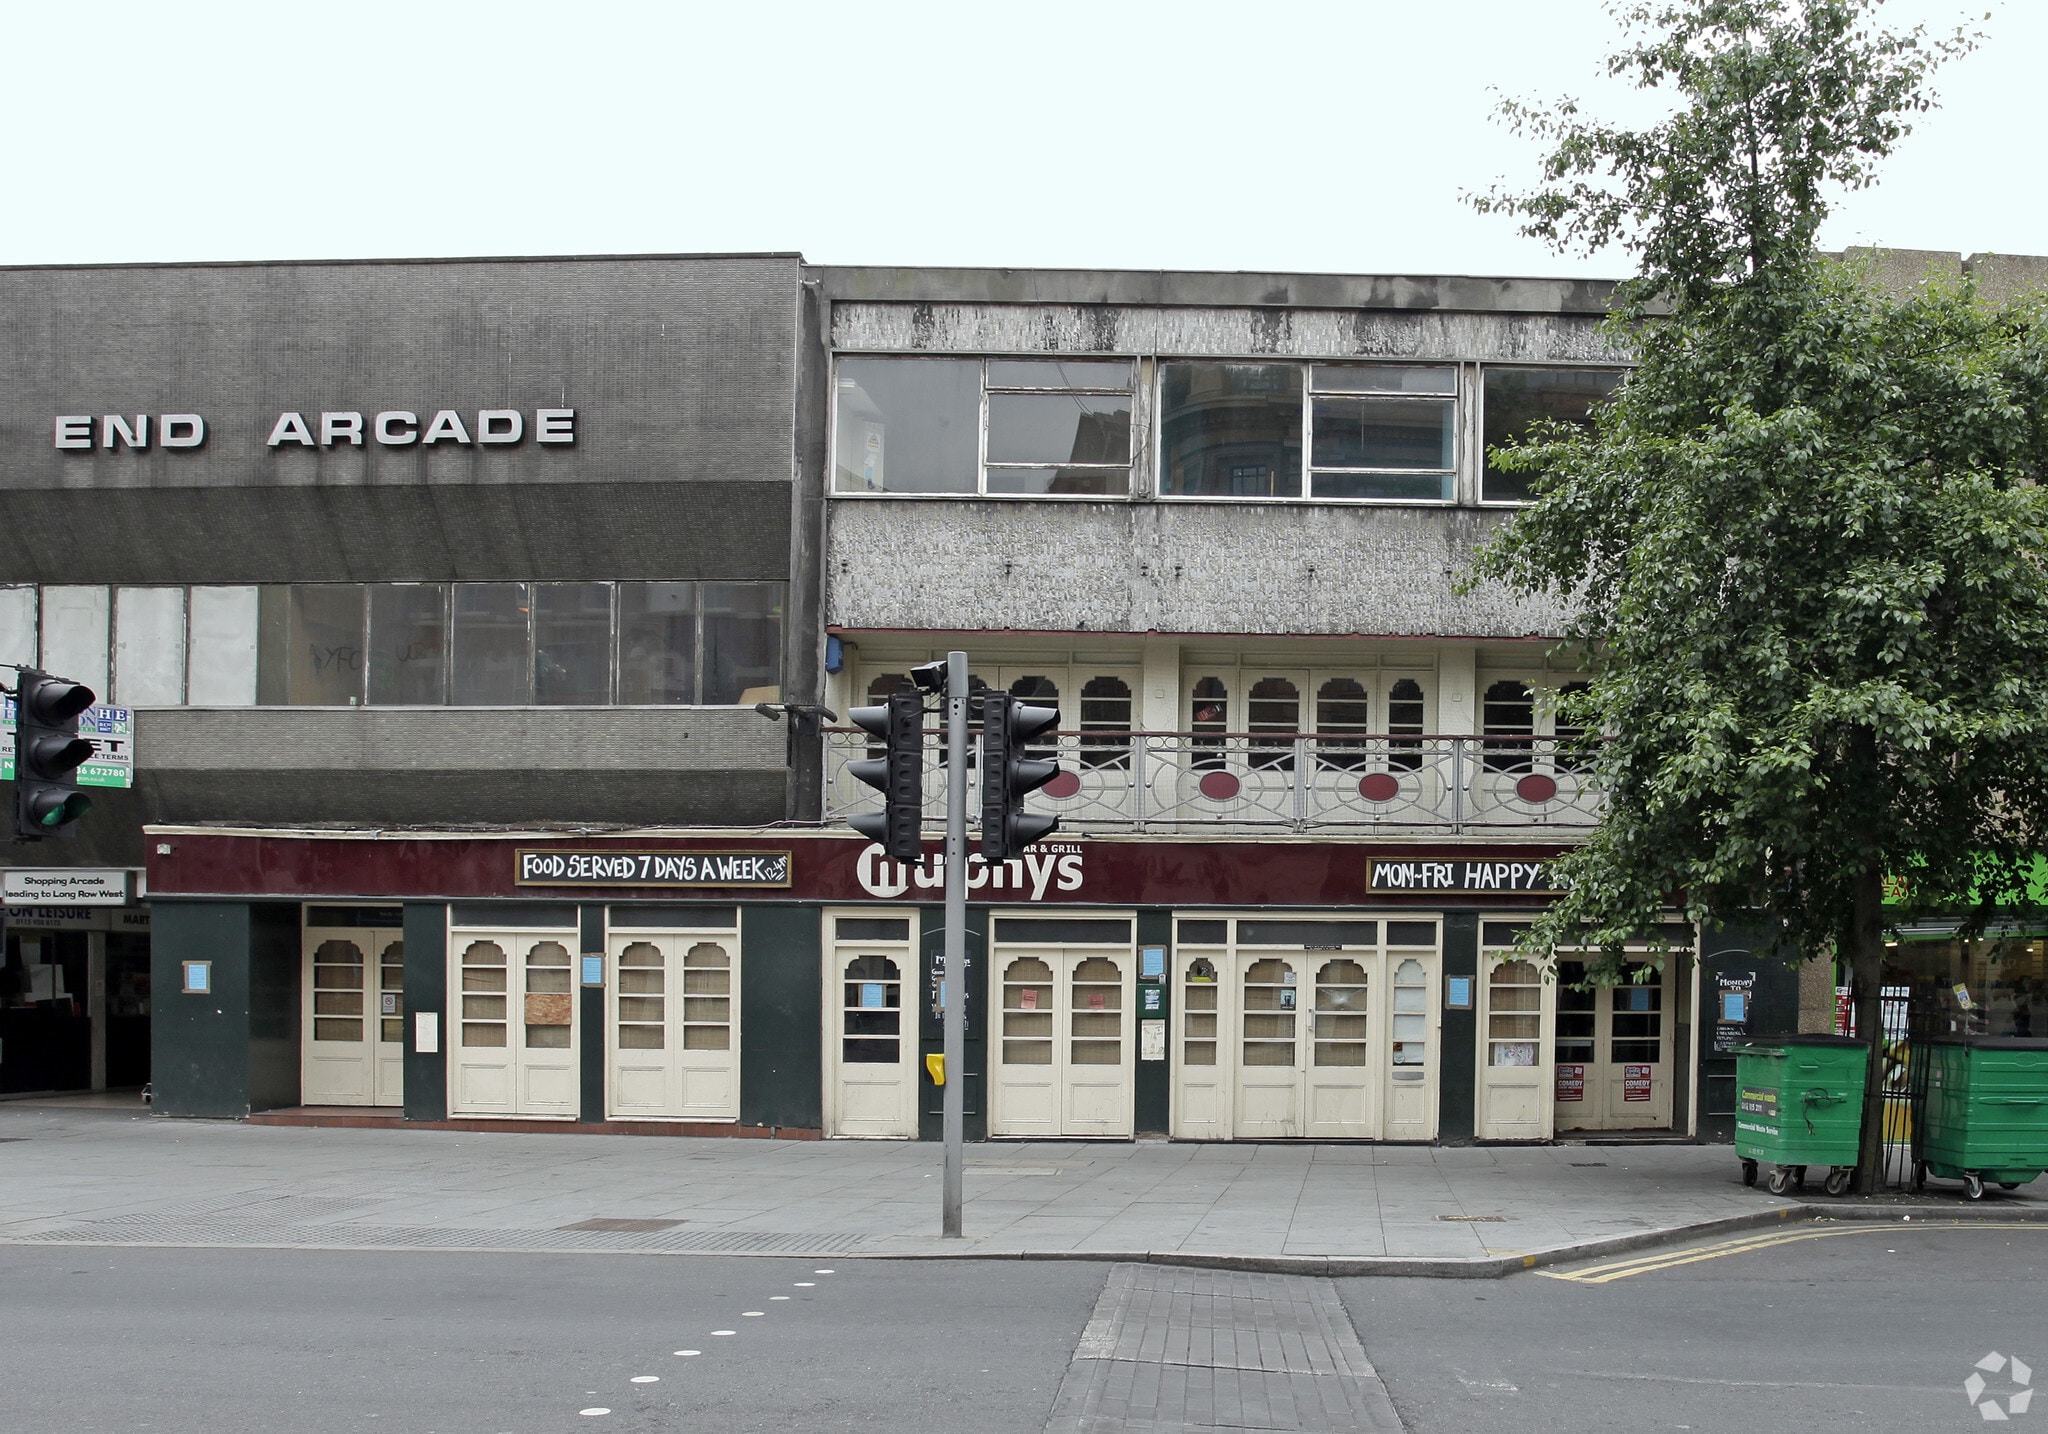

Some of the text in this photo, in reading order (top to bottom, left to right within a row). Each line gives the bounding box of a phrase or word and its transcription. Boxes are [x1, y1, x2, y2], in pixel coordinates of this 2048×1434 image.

[55, 408, 574, 449] END ARCADE
[90, 768, 125, 777] 672780
[1023, 844, 1083, 853] AR & GRILL
[523, 854, 565, 879] FOOD
[567, 854, 636, 879] SERVED
[638, 855, 651, 879] 7
[654, 856, 697, 881] DAYS
[700, 857, 716, 881] A
[717, 857, 766, 881] WEEK
[24, 877, 105, 886] Shopping Arcade
[1464, 862, 1540, 890] HAPPY
[5, 890, 39, 899] leading
[53, 890, 76, 900] Long
[78, 890, 97, 898] Row
[99, 890, 124, 898] West
[38, 908, 91, 920] LEISURE
